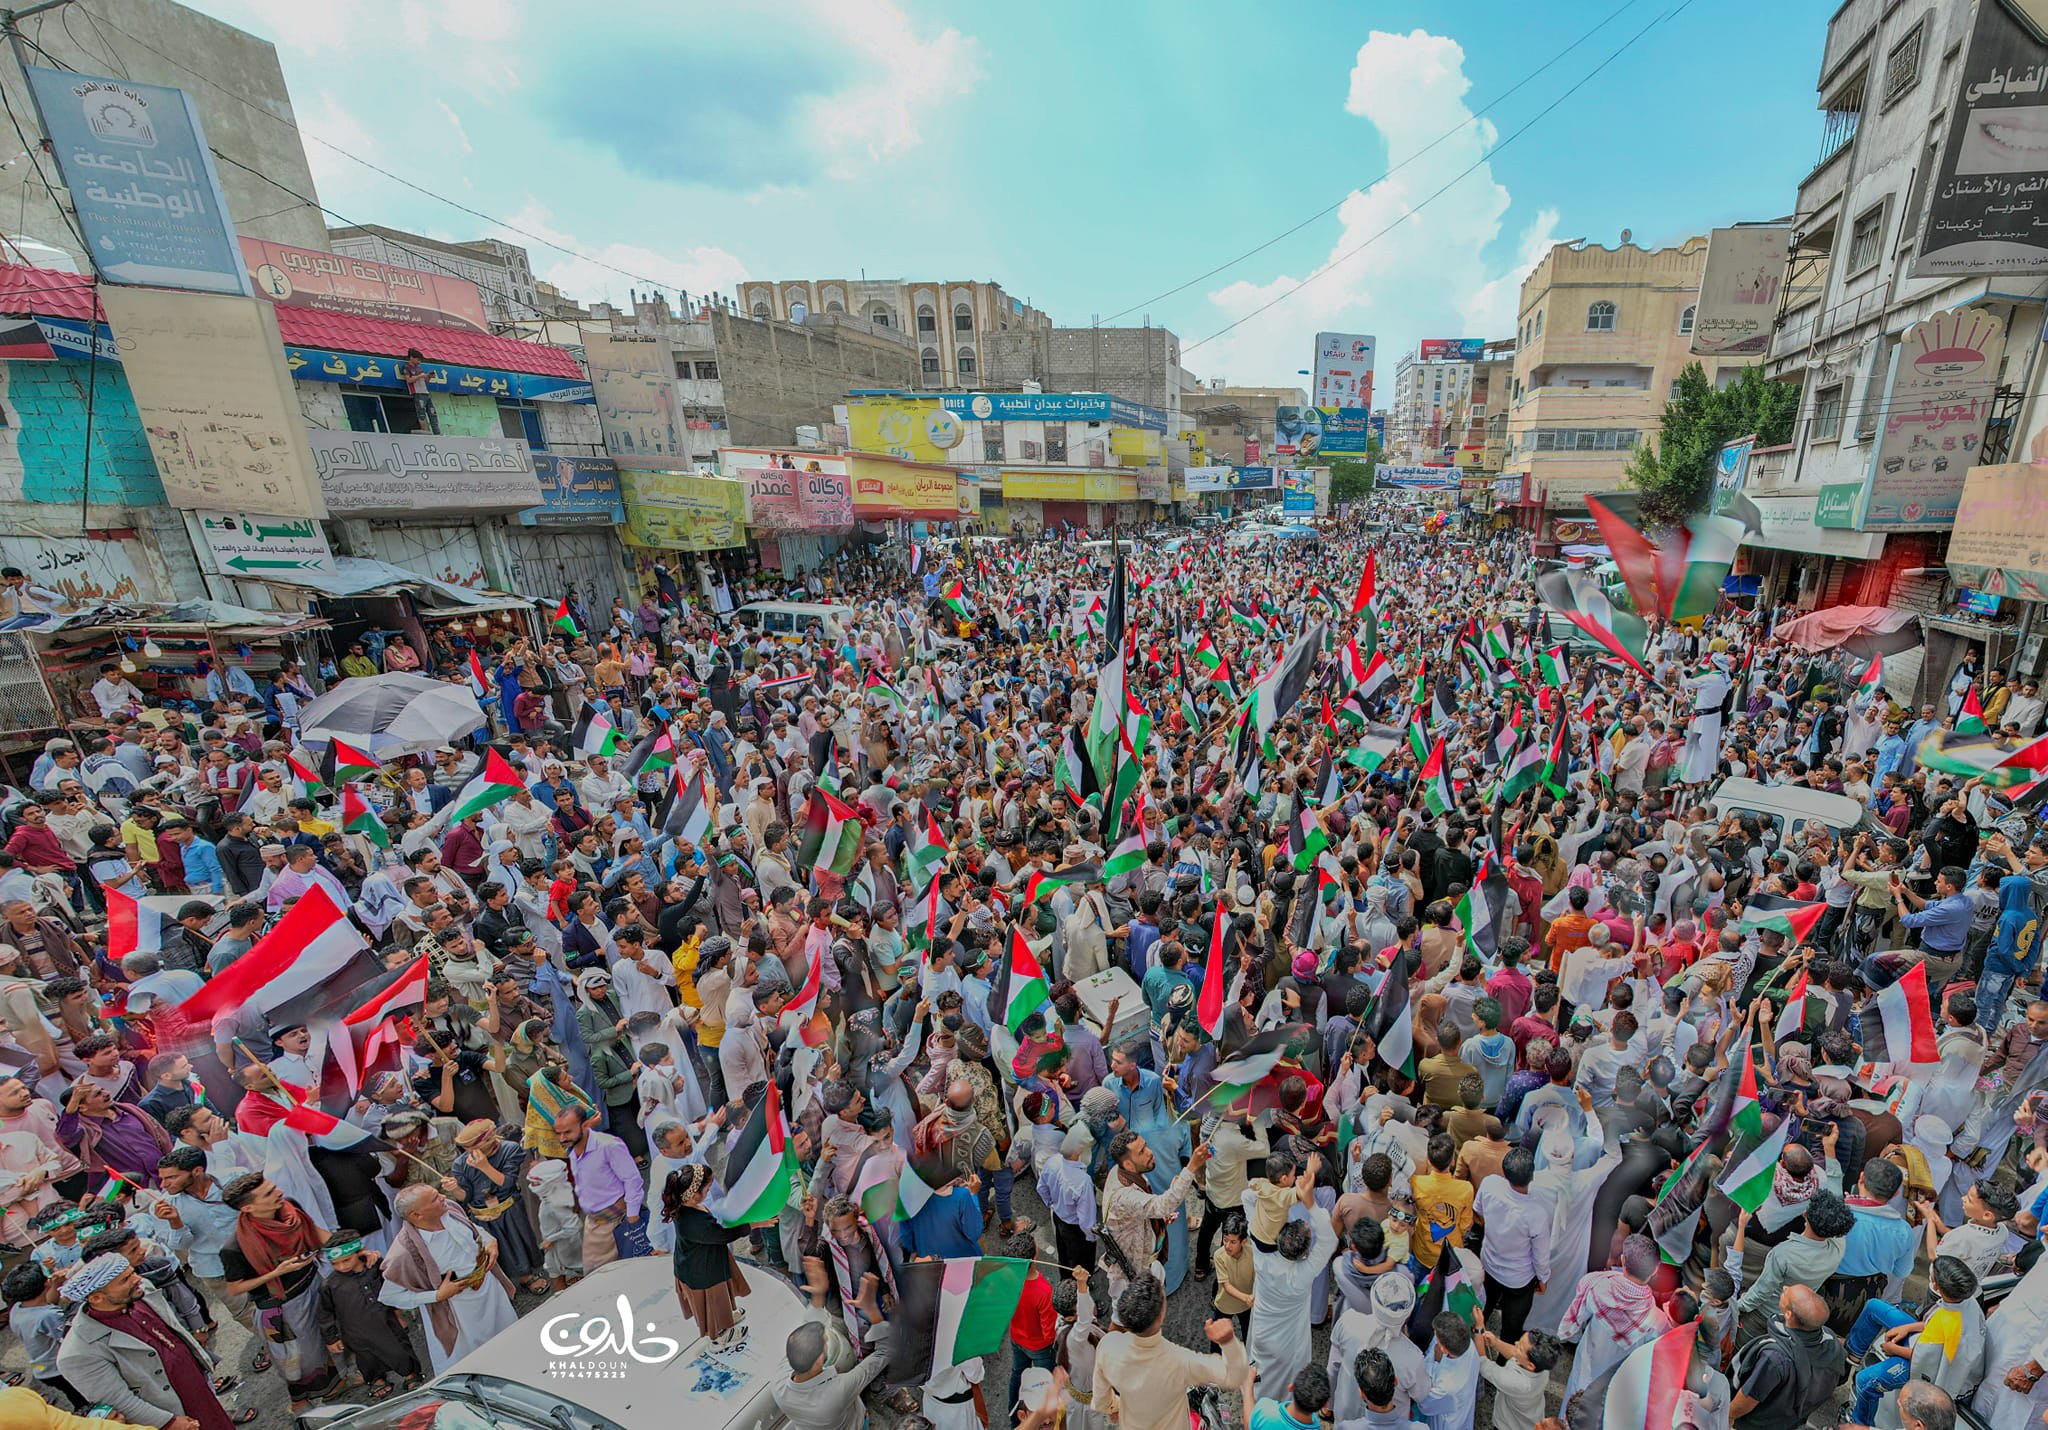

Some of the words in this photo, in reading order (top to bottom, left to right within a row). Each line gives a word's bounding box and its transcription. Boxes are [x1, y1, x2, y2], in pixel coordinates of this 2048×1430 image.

[1966, 65, 2048, 108] القباطي
[73, 146, 197, 187] الجامعة
[86, 180, 206, 219] الوطنية
[1941, 177, 2013, 199] والأسنان
[1984, 200, 2034, 215] تقويم
[1936, 218, 1984, 232] تركيبات
[2002, 230, 2030, 239] يوجد
[281, 251, 349, 278] العربي
[352, 262, 425, 296] إستراحة
[1323, 350, 1346, 359] USAID
[1351, 352, 1364, 362] care
[1933, 362, 1963, 375] كنج
[321, 354, 384, 390] غرف
[395, 363, 449, 393] لدا
[459, 369, 511, 396] يوجد
[572, 383, 597, 397] ستراحة
[1937, 390, 1969, 400] محلات
[999, 398, 1031, 410] الطبية
[1065, 399, 1106, 411] مختبرات
[1887, 398, 1987, 434] المحويتي
[311, 440, 378, 480] العر
[384, 442, 463, 480] مقبل
[466, 442, 529, 474] أحمد
[809, 476, 844, 499] وكالة
[242, 512, 317, 543] الهجرة
[36, 548, 86, 570] محلات
